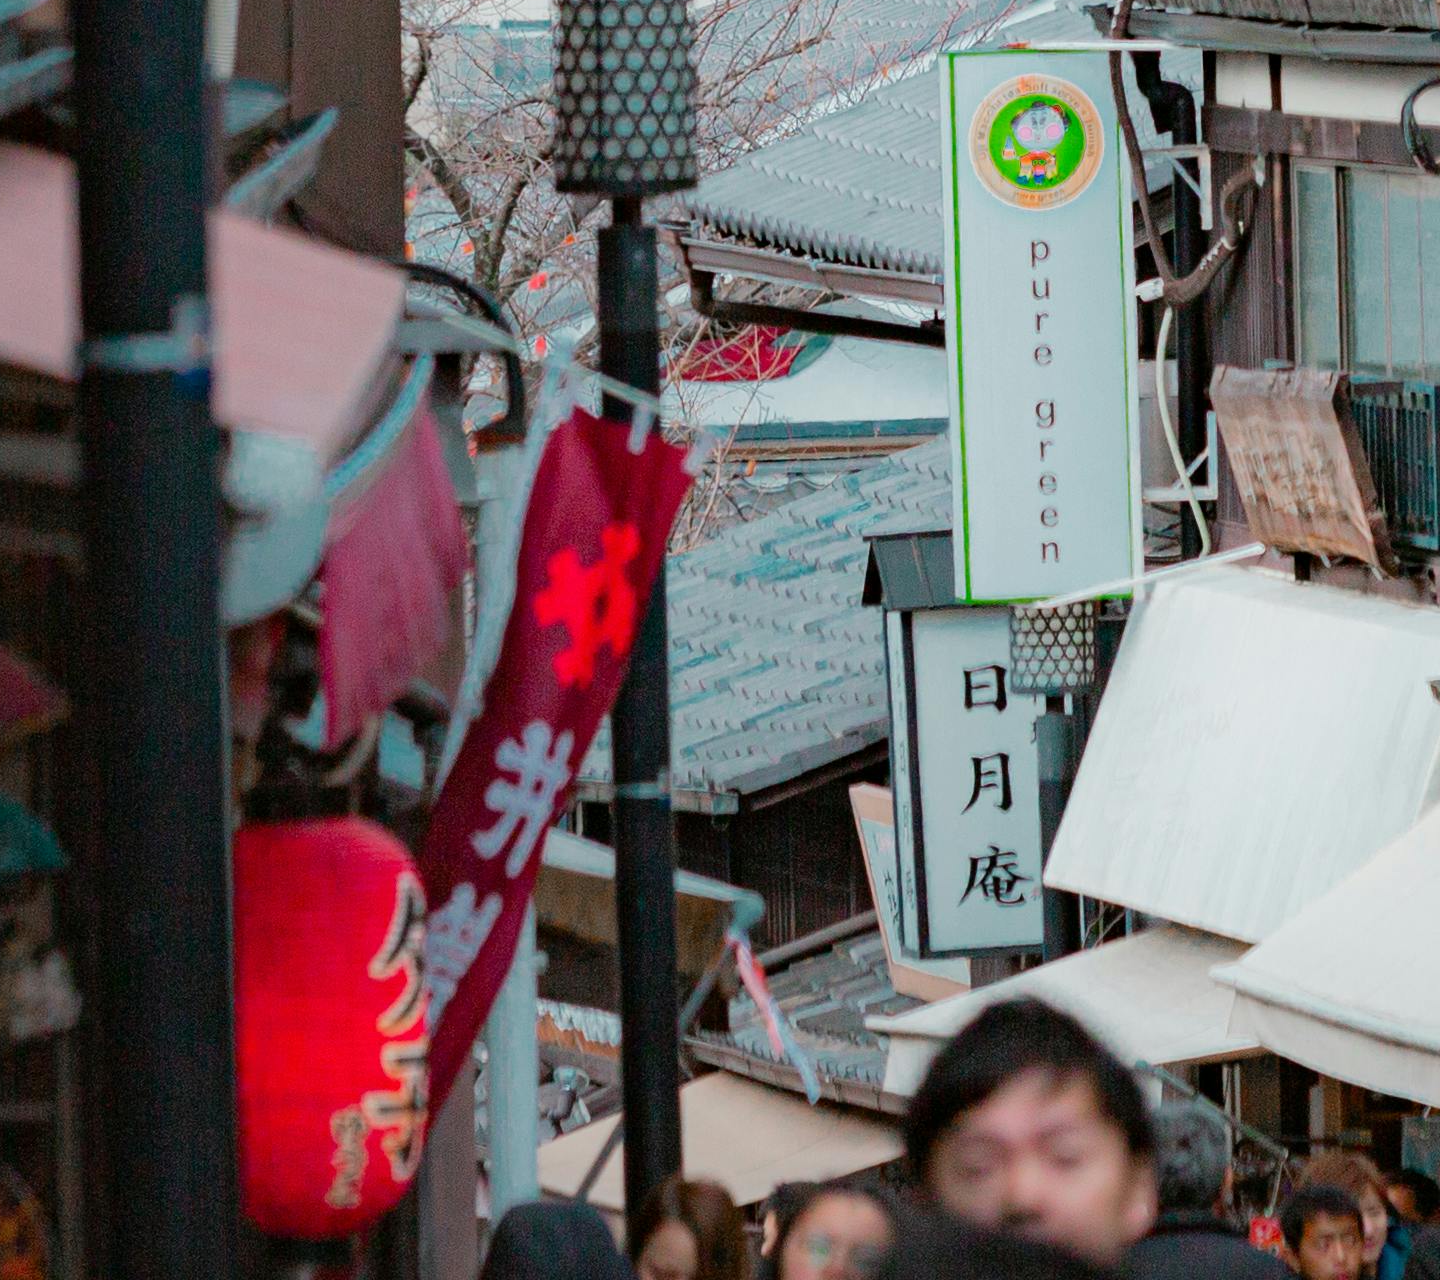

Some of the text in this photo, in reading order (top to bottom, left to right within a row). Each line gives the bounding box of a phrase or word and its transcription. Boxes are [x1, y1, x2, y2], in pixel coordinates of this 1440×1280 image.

[1030, 239, 1060, 563] pure green
[958, 663, 1034, 908] 日月庵
